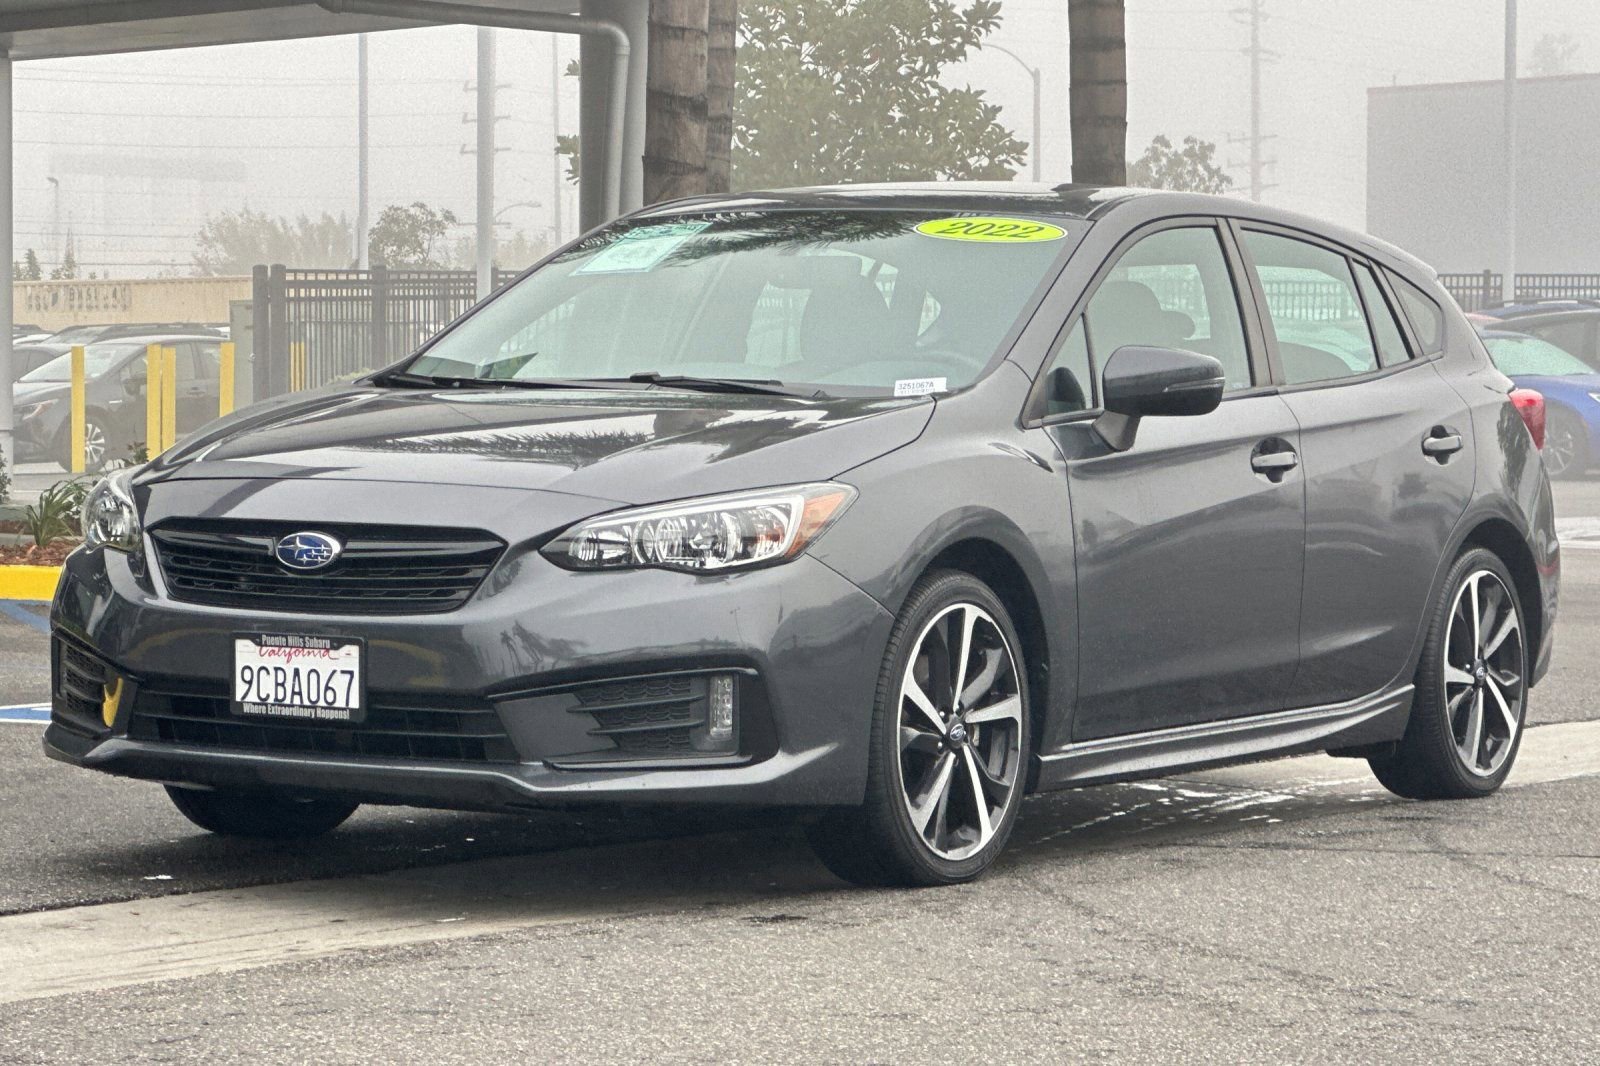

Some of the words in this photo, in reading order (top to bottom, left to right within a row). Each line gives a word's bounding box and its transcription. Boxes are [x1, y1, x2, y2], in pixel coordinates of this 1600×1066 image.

[936, 221, 1044, 239] 2022
[897, 381, 934, 390] 3251067A
[261, 635, 286, 646] Puente
[288, 636, 303, 647] Hills
[305, 637, 330, 648] Subaru
[259, 646, 339, 664] California
[240, 665, 355, 707] 9CBA067
[243, 703, 266, 715] Where
[268, 704, 316, 718] Extraordinary
[317, 707, 350, 719] Happens!
